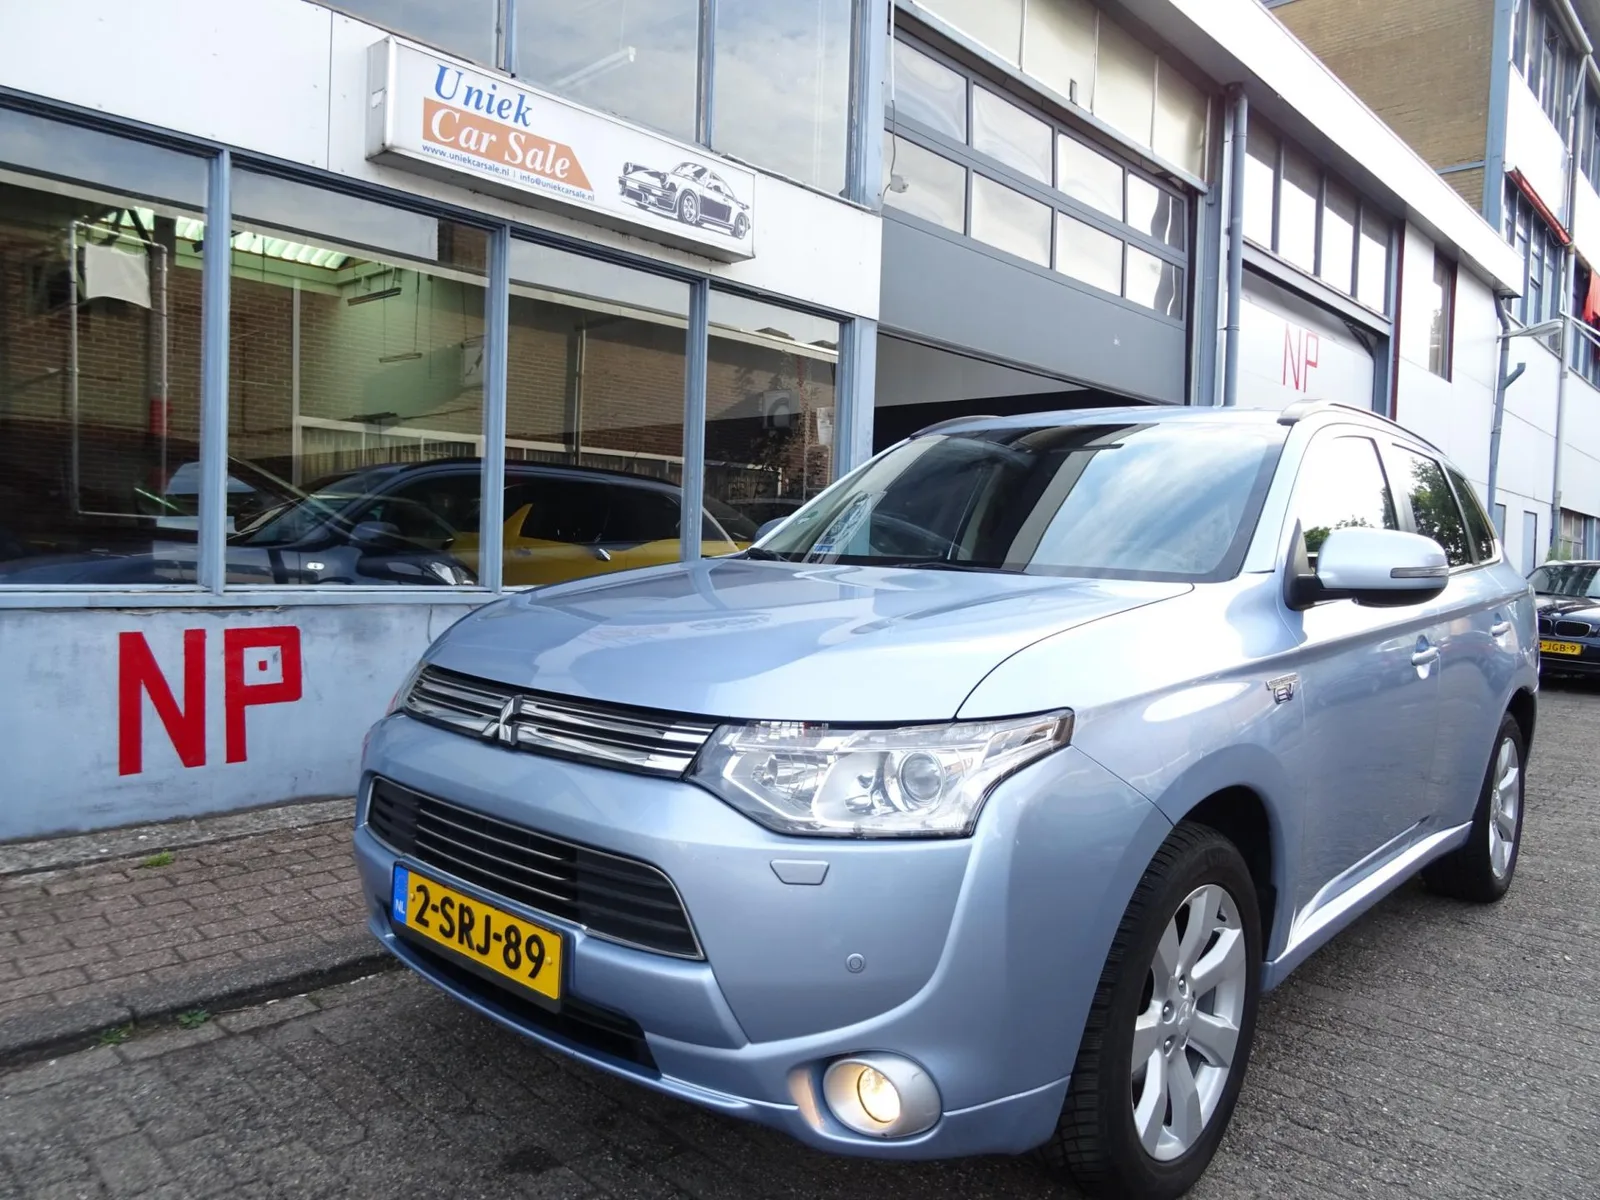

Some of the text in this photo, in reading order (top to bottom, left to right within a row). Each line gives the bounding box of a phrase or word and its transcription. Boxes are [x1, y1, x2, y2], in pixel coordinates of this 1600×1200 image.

[434, 64, 533, 128] Uniek
[421, 144, 510, 176] www.uniekcarsale.nl
[519, 173, 596, 201] info@uniekcarsale.nl
[431, 108, 571, 179] Car Sale
[1282, 323, 1320, 394] NP
[119, 625, 303, 777] NP
[394, 898, 406, 914] NL
[414, 884, 546, 980] 2-SRJ-89
